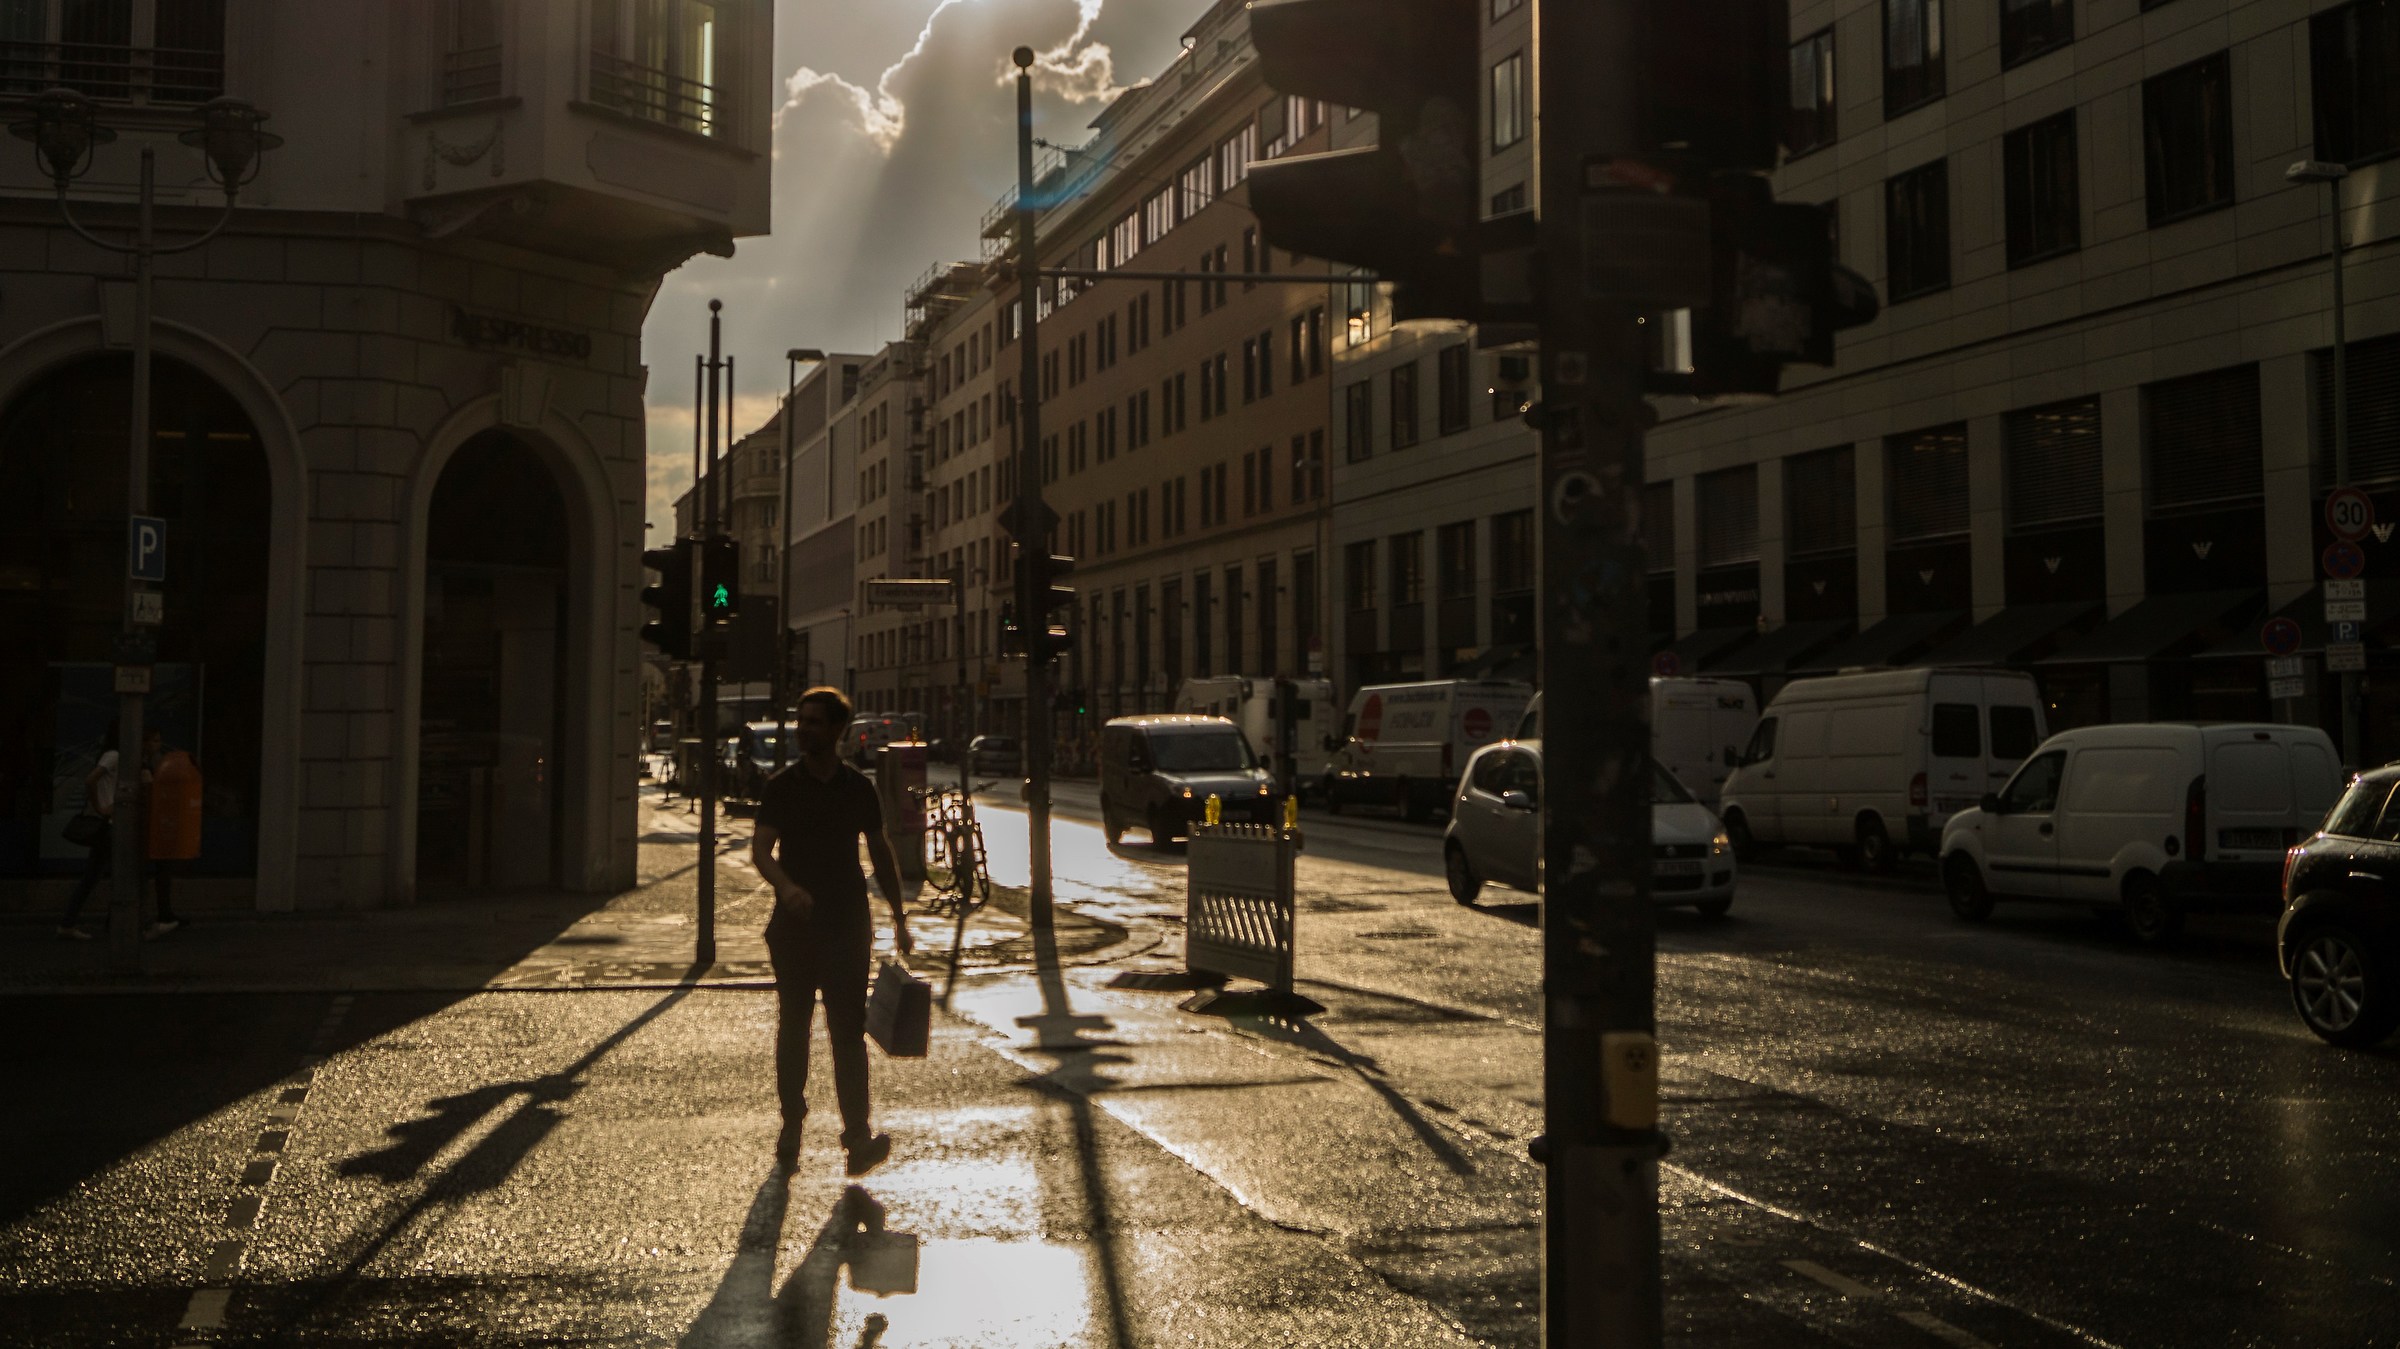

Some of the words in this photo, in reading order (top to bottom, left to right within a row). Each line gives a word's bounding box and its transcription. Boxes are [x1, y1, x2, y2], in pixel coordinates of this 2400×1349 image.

[452, 305, 592, 359] NESPRESSO
[2336, 502, 2363, 526] 30
[138, 525, 158, 571] P
[2339, 622, 2352, 641] P
